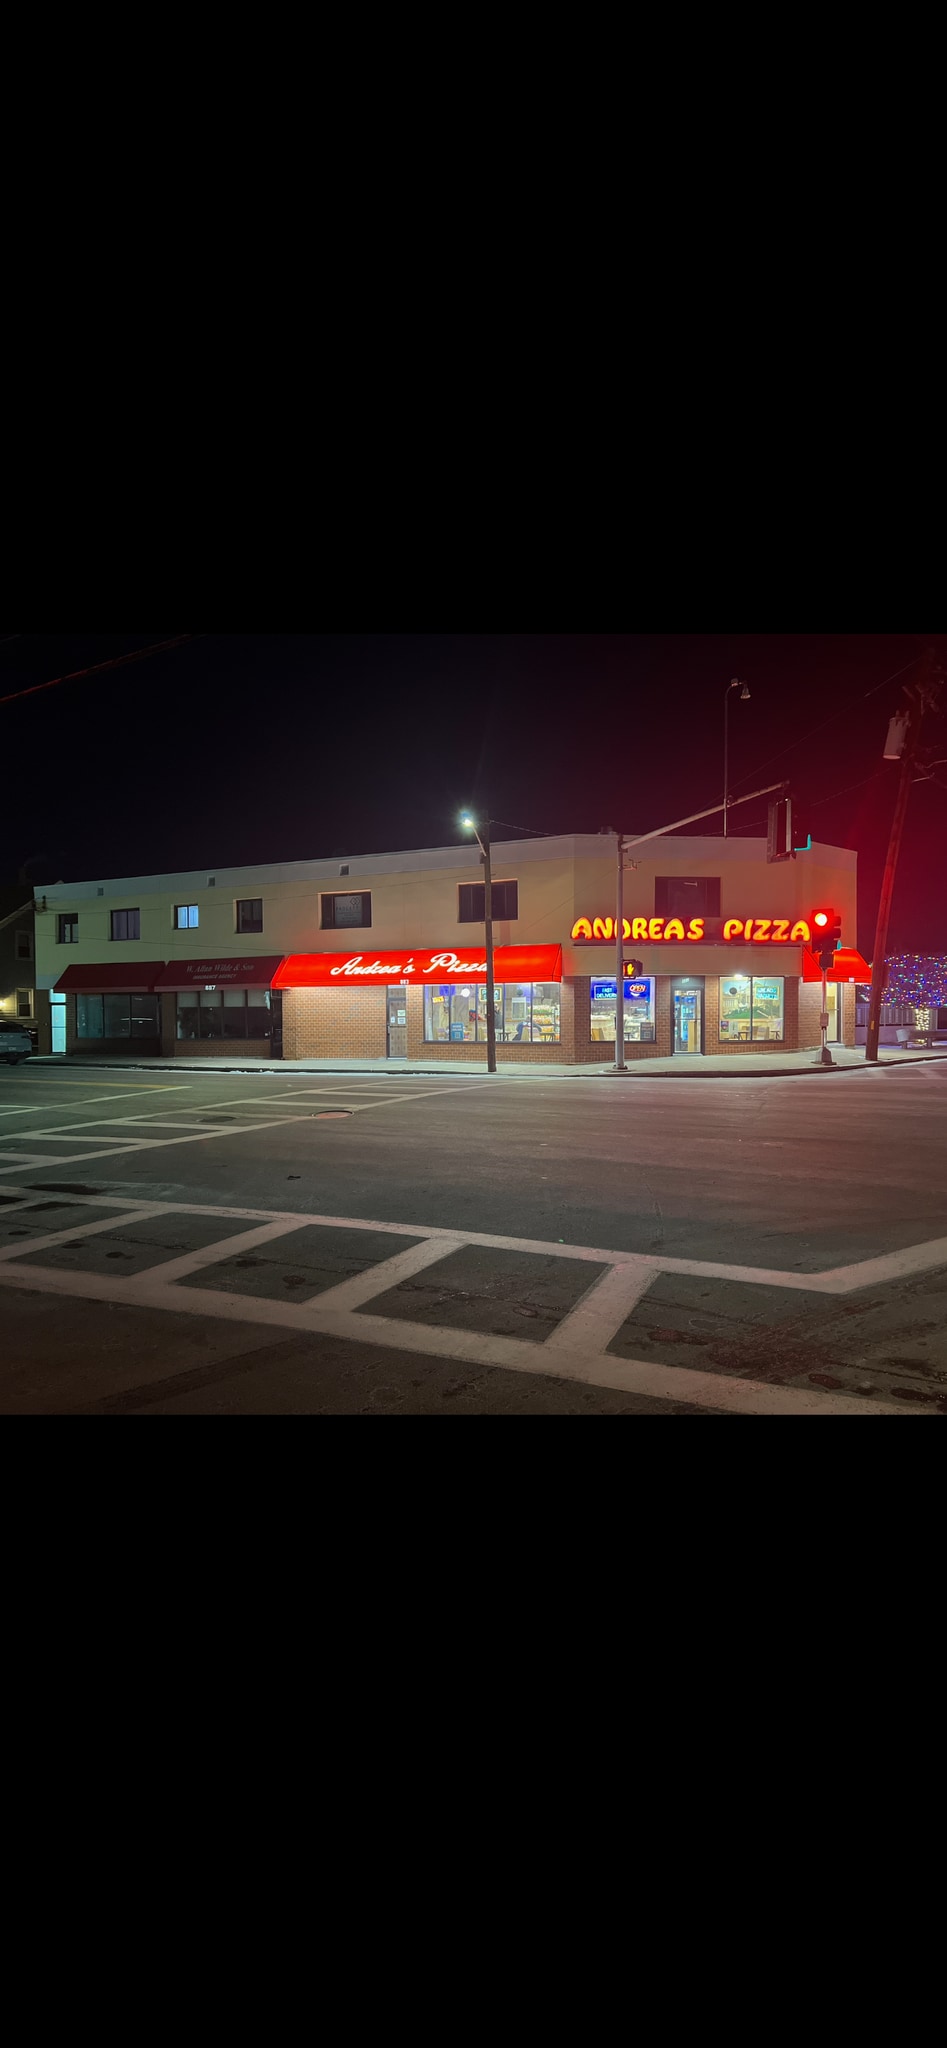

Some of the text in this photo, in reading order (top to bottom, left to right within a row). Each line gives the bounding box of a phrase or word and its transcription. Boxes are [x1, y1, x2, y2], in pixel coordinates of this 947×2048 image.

[571, 916, 811, 942] ANDREAS PIZZA
[214, 964, 233, 972] Wilde
[241, 963, 254, 971] Son
[330, 956, 416, 975] Andrea's
[629, 984, 646, 992] OPEN
